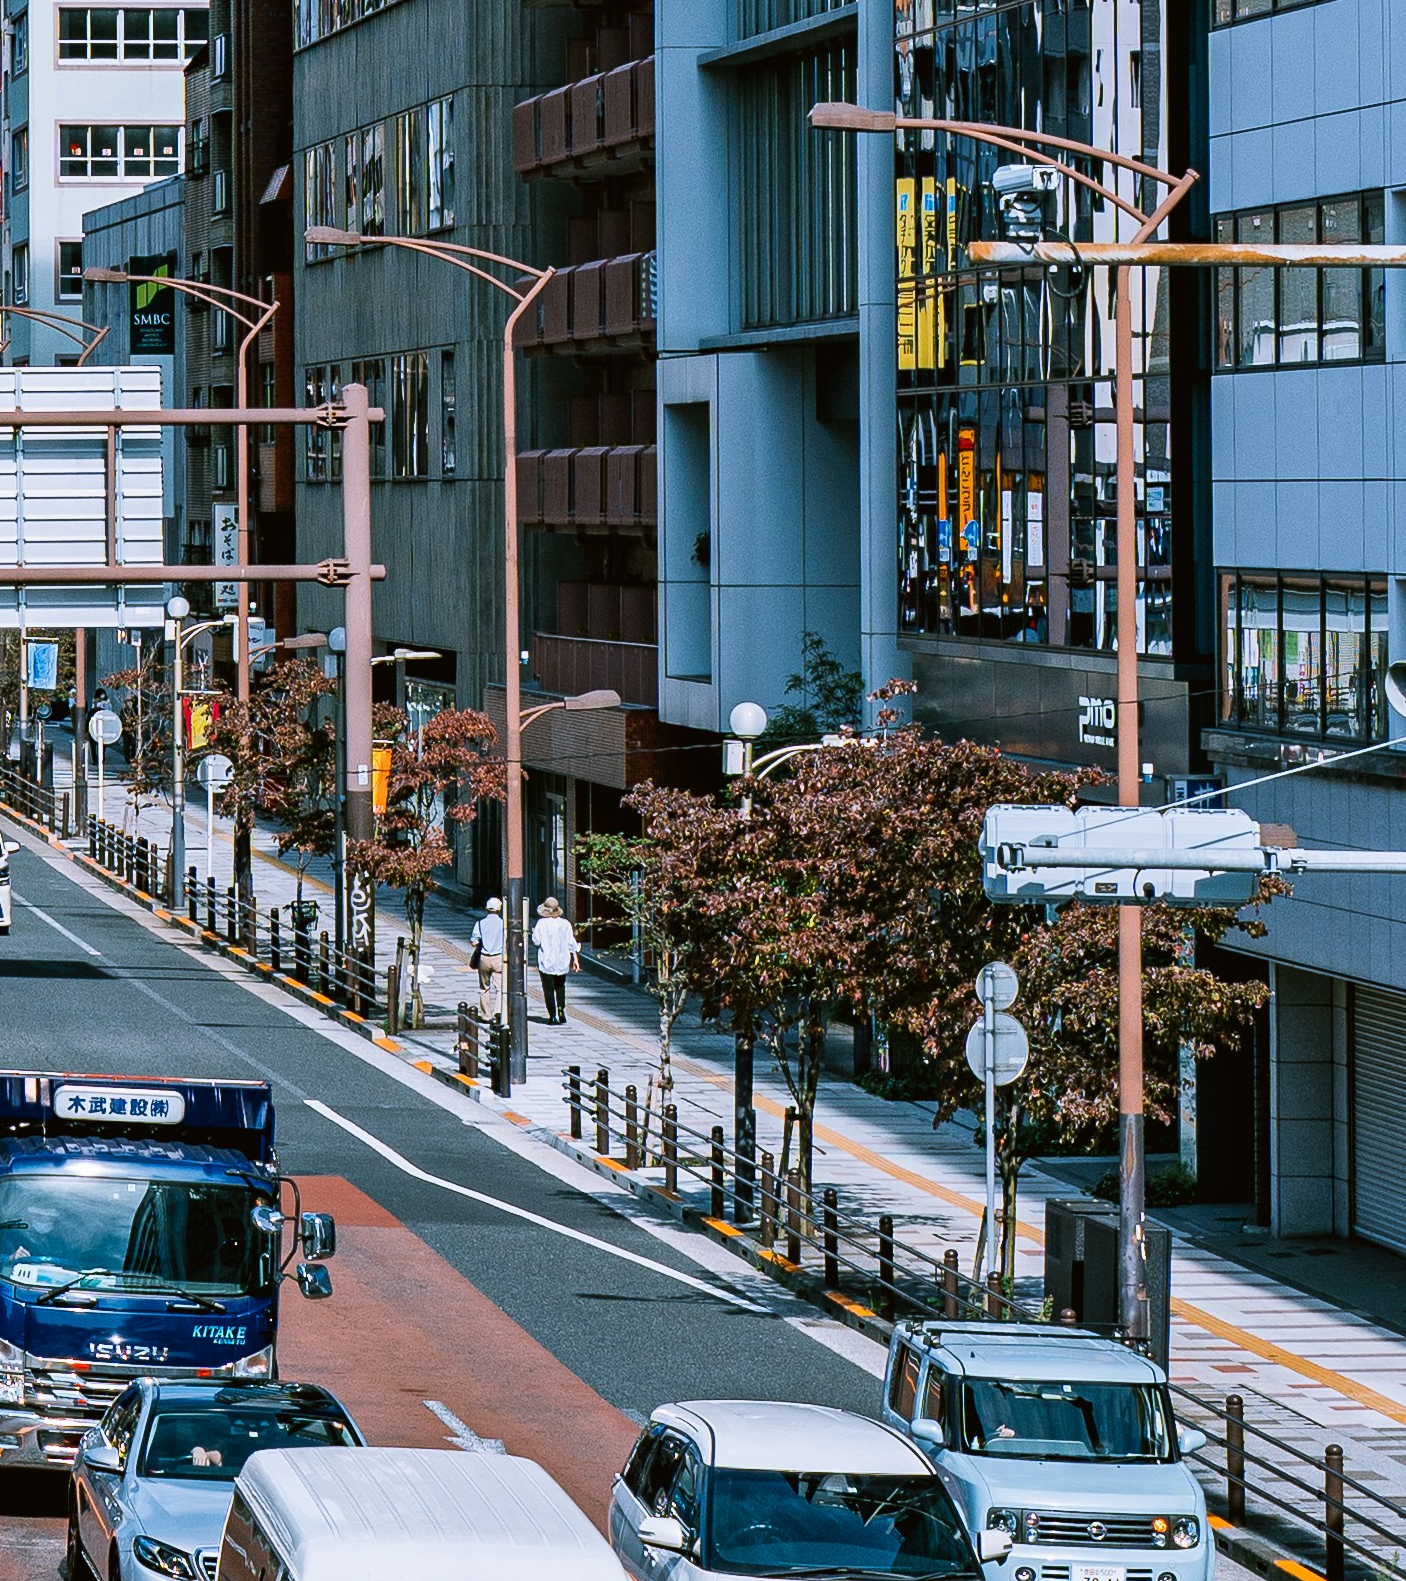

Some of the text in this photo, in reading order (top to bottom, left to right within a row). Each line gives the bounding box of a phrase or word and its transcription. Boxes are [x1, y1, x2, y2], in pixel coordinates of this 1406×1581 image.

[133, 313, 170, 325] SMBC
[220, 517, 237, 596] おそば処
[192, 1325, 247, 1339] KITAKE
[90, 1343, 169, 1362] ISUZU
